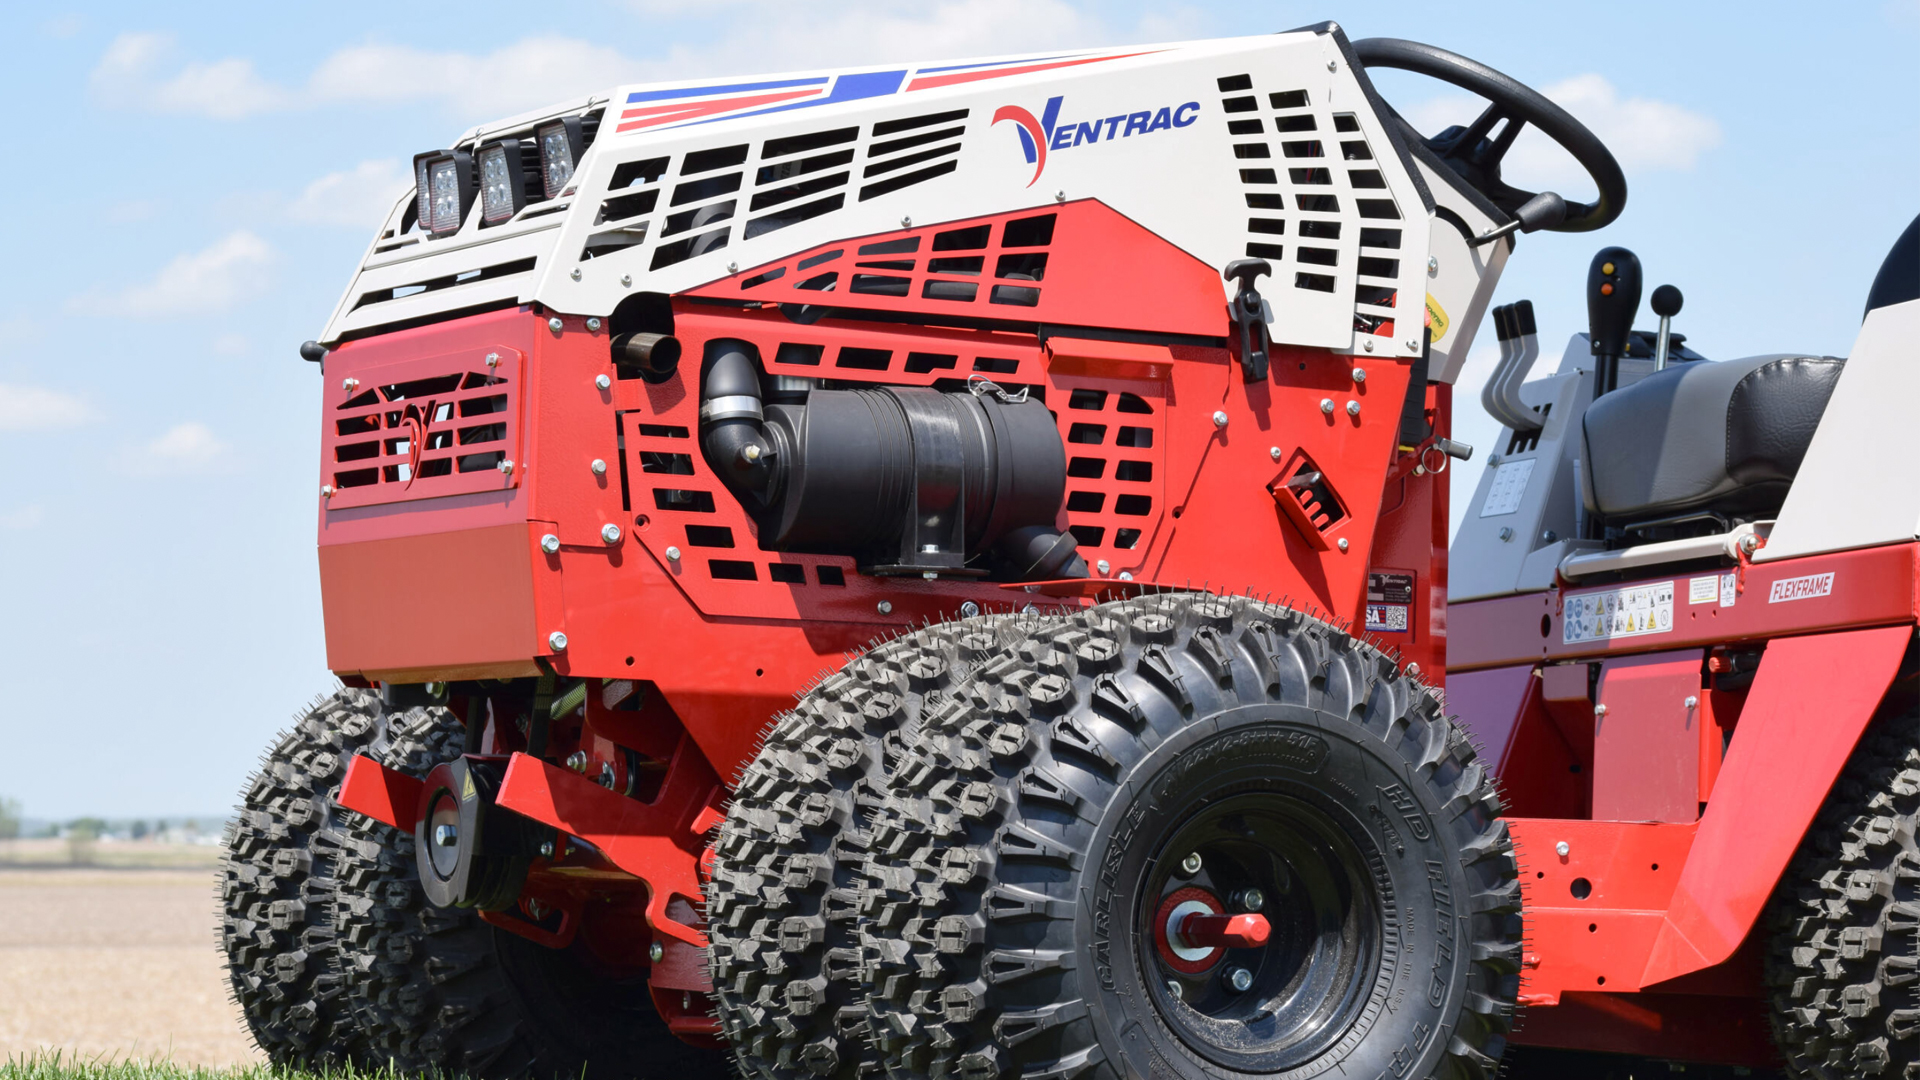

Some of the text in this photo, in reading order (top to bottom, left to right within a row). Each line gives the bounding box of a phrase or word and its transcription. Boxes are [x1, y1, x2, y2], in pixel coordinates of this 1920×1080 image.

[990, 95, 1201, 189] VENTRAC
[1772, 575, 1832, 601] FLEXFRAME
[1366, 609, 1380, 623] SA
[1094, 799, 1147, 992] CARLISLE
[1381, 783, 1431, 840] HD
[1425, 859, 1453, 1008] FIELD
[1406, 907, 1415, 937] MADE
[1406, 943, 1415, 954] IN
[1401, 962, 1412, 981] THE
